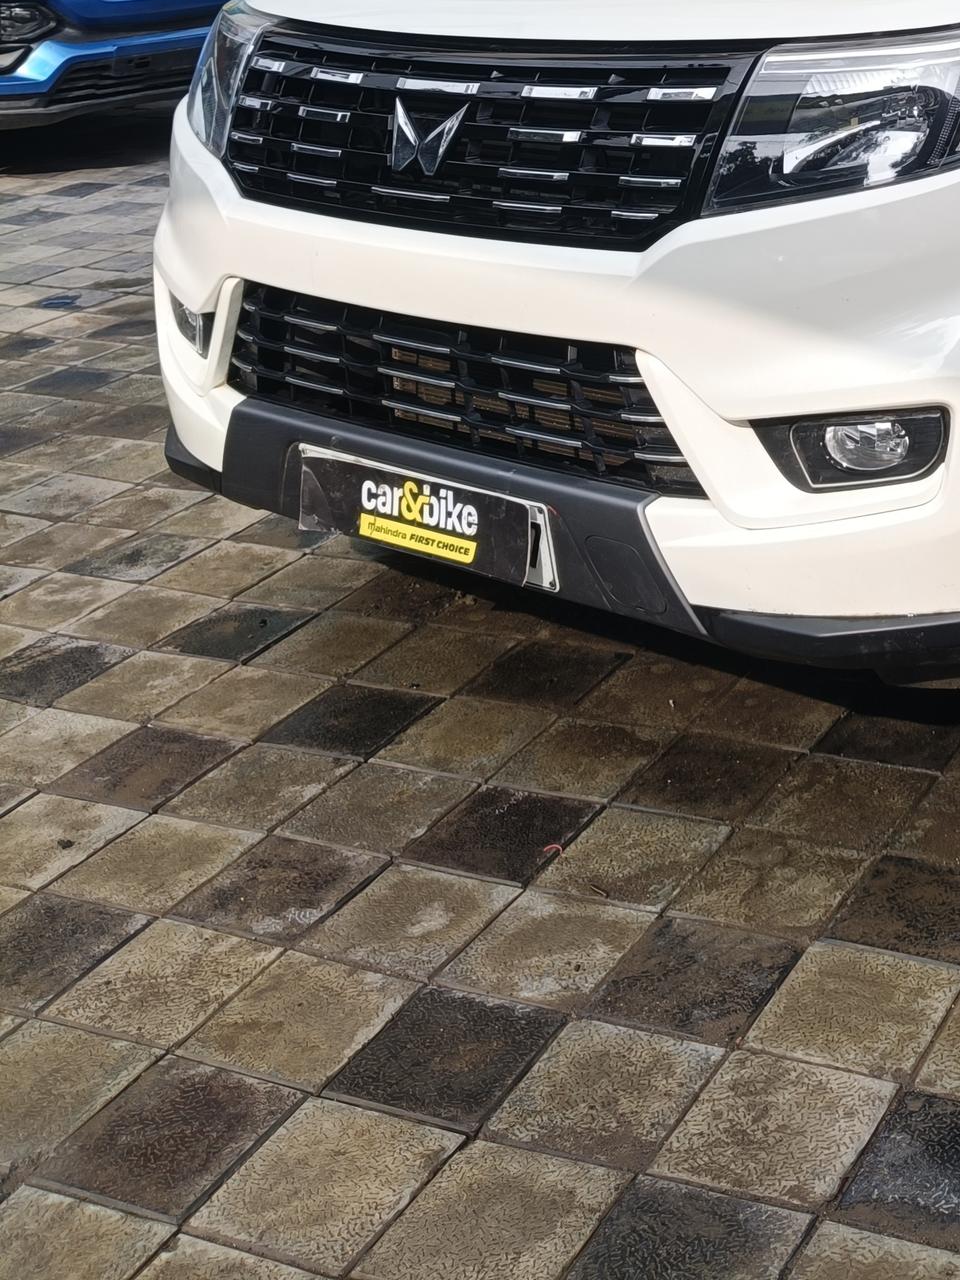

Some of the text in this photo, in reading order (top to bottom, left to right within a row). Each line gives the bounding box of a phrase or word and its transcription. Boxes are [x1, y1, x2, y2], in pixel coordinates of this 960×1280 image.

[361, 480, 478, 536] car&bike
[409, 533, 436, 547] FIRST
[437, 541, 470, 556] CHOICE
